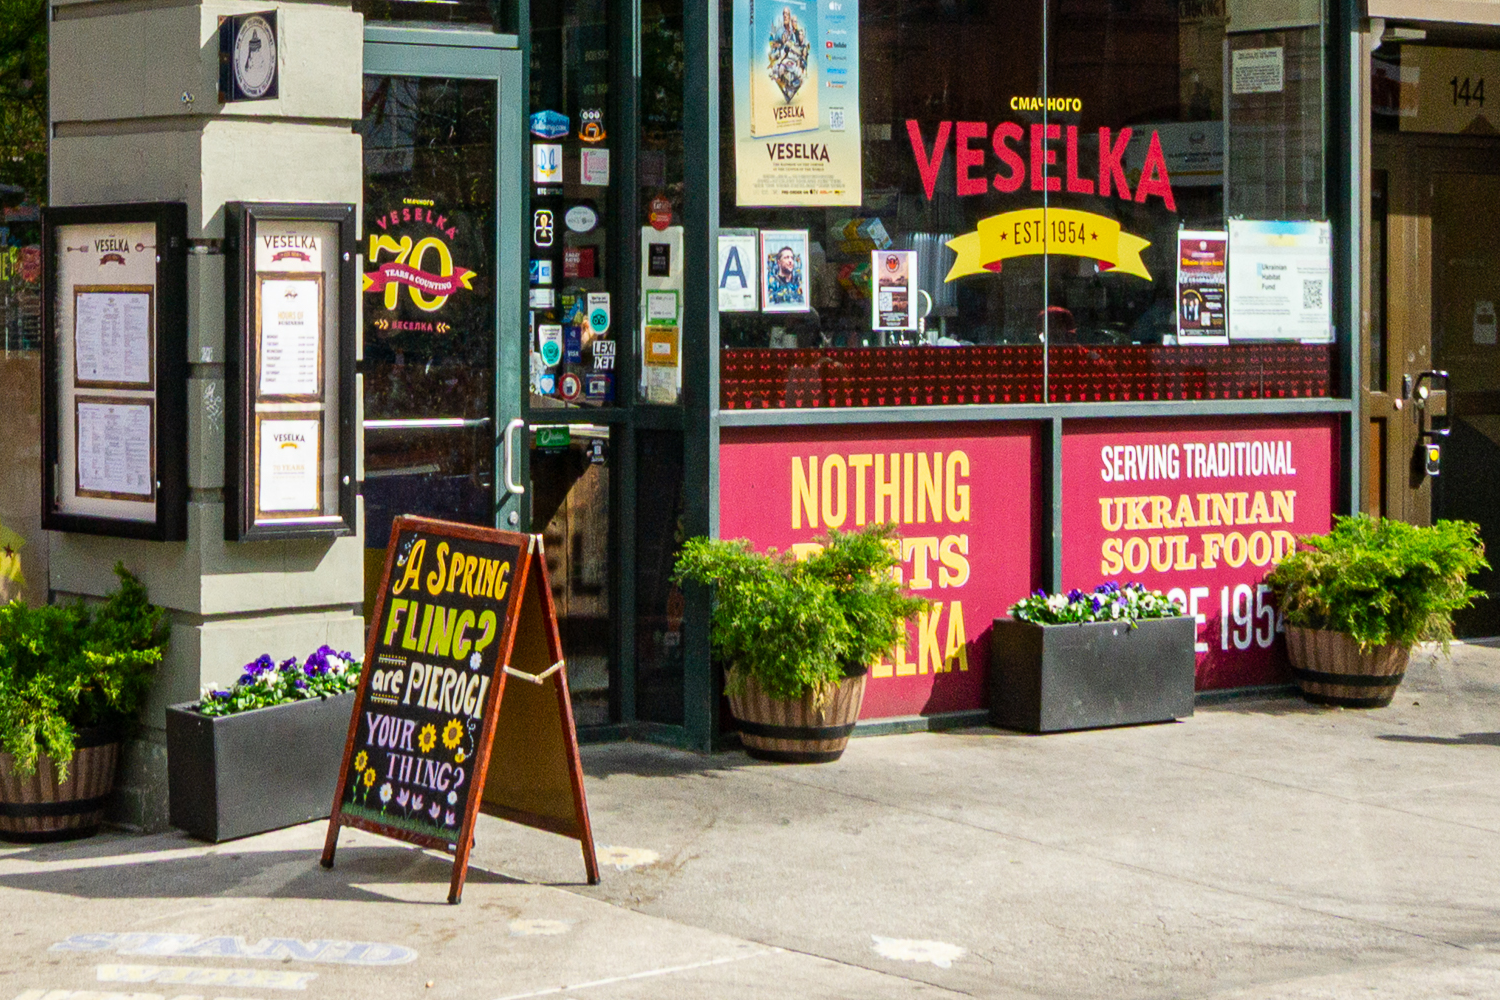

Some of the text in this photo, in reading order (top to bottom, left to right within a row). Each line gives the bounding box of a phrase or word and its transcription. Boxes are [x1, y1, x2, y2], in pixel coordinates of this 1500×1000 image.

[1010, 97, 1082, 112] СМАЧНОГО
[1451, 76, 1486, 107] 144
[773, 106, 805, 121] VESELKA
[766, 143, 830, 163] VESELKA
[905, 119, 1177, 213] VESELKA
[376, 207, 457, 240] VESELKA
[1013, 221, 1087, 246] EST. 1954
[94, 239, 130, 254] VESELKA
[263, 234, 317, 251] VESELKA
[369, 234, 454, 312] 70
[385, 269, 409, 280] YEARS
[414, 276, 452, 290] COUNTING
[719, 245, 748, 289] A
[1262, 263, 1287, 271] Ukrainian
[594, 342, 615, 354] LEXI
[273, 433, 306, 443] VESELKA
[1101, 440, 1297, 482] SERVING TRADITIONAL
[791, 450, 970, 529] NOTHING
[1099, 490, 1297, 532] UKRAINIAN
[392, 538, 511, 601] A SPRING
[1101, 530, 1297, 576] SOUL FOOD
[383, 598, 497, 661] FLING?
[371, 661, 490, 720] are PIEROGI
[366, 711, 416, 752] YOUR
[386, 752, 465, 791] THING?
[47, 931, 418, 966] STAND
